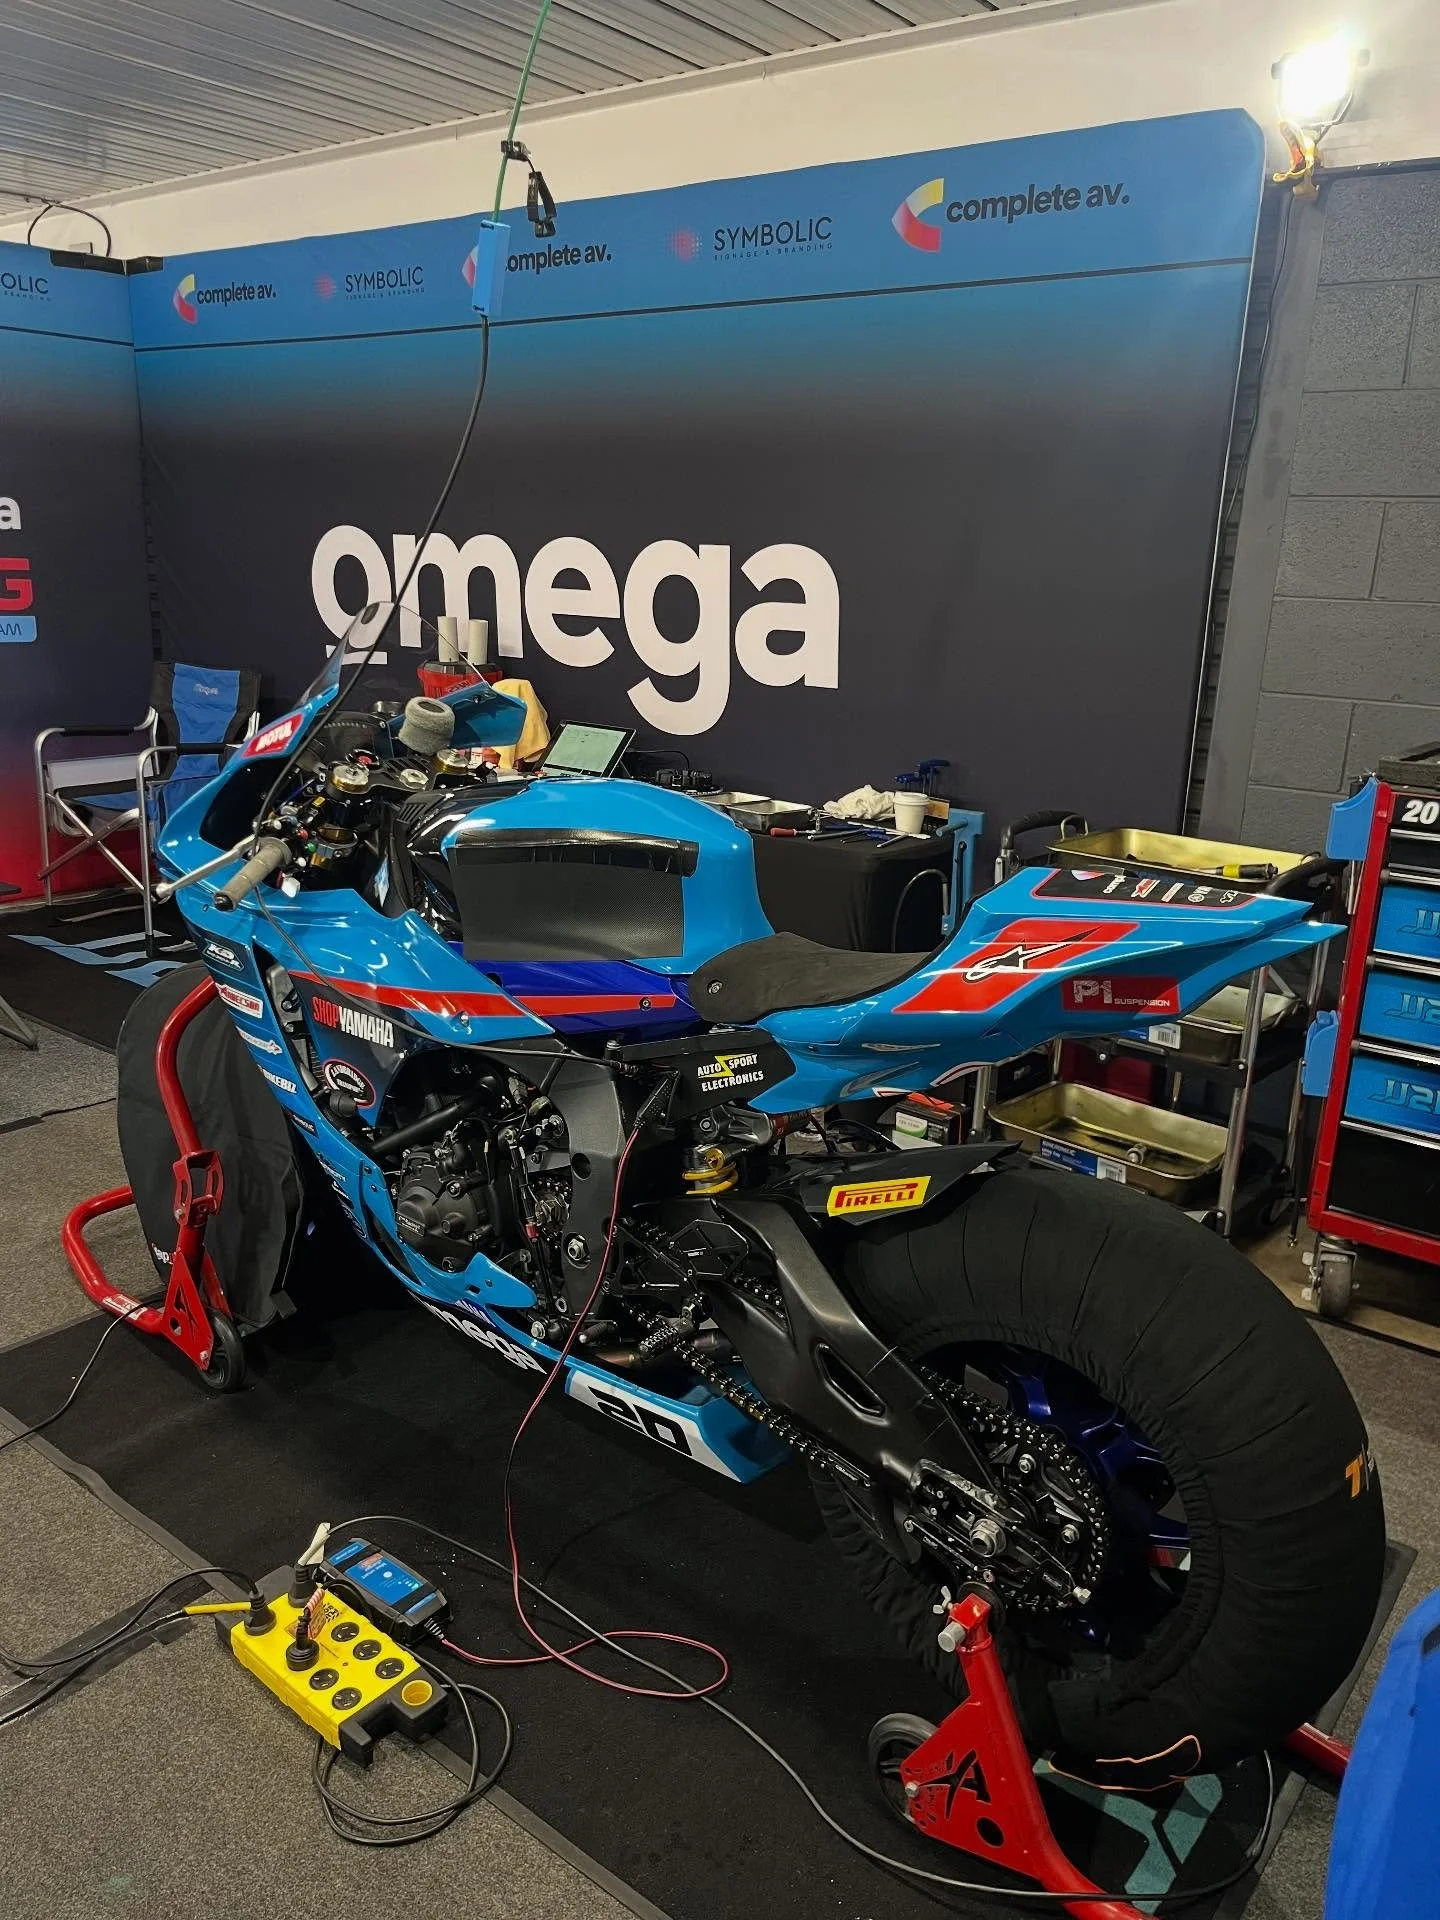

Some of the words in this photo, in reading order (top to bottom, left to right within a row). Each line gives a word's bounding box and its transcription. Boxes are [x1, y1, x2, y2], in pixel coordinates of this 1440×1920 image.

[946, 183, 1082, 224] complete
[1086, 183, 1130, 208] av.
[714, 216, 832, 251] SYMBOLIC
[505, 244, 581, 274] omplete
[585, 244, 612, 263] av.
[345, 266, 424, 293] SYMBOLIC
[196, 282, 255, 308] complete
[257, 282, 277, 300] av.
[311, 524, 841, 737] omega
[1114, 999, 1171, 1008] SUSPENSION
[698, 1061, 722, 1078] AUTO
[728, 1054, 758, 1070] SPORT
[701, 1071, 764, 1092] ELECTRONICS
[834, 1182, 919, 1209] PIRELLI
